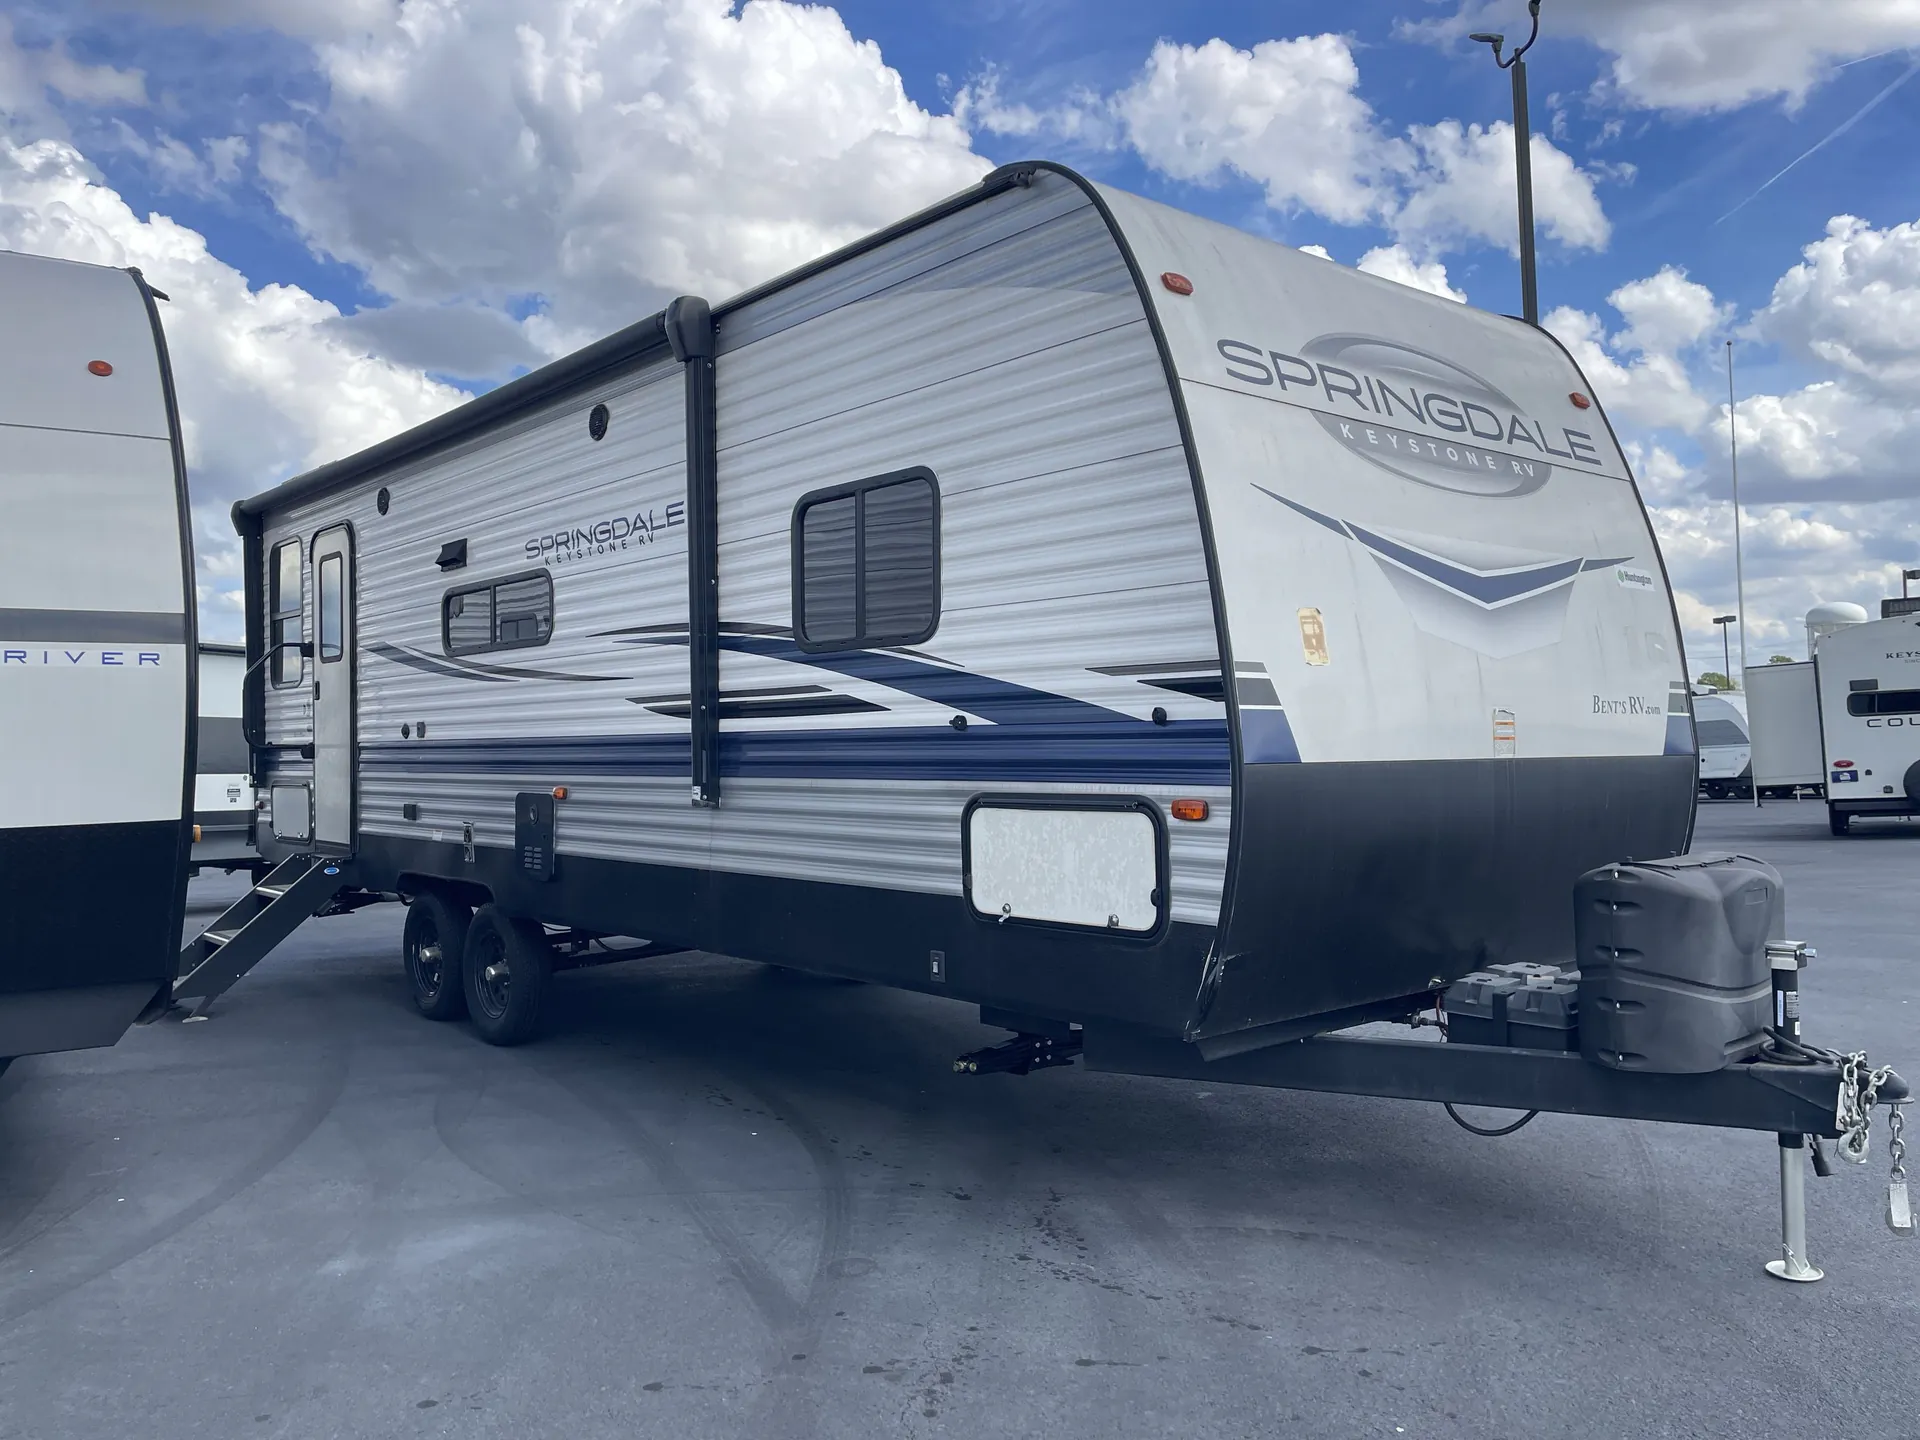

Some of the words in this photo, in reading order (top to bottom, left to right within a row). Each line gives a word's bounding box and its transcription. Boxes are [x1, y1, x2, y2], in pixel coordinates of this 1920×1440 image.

[1217, 338, 1602, 466] SPRINGDALE
[1339, 422, 1497, 470] KEYSTONE
[1511, 460, 1535, 478] RV
[524, 500, 685, 560] SPRINGDALE
[544, 539, 628, 566] KEYSTONE
[638, 531, 655, 546] RV
[3, 650, 161, 666] RIVER
